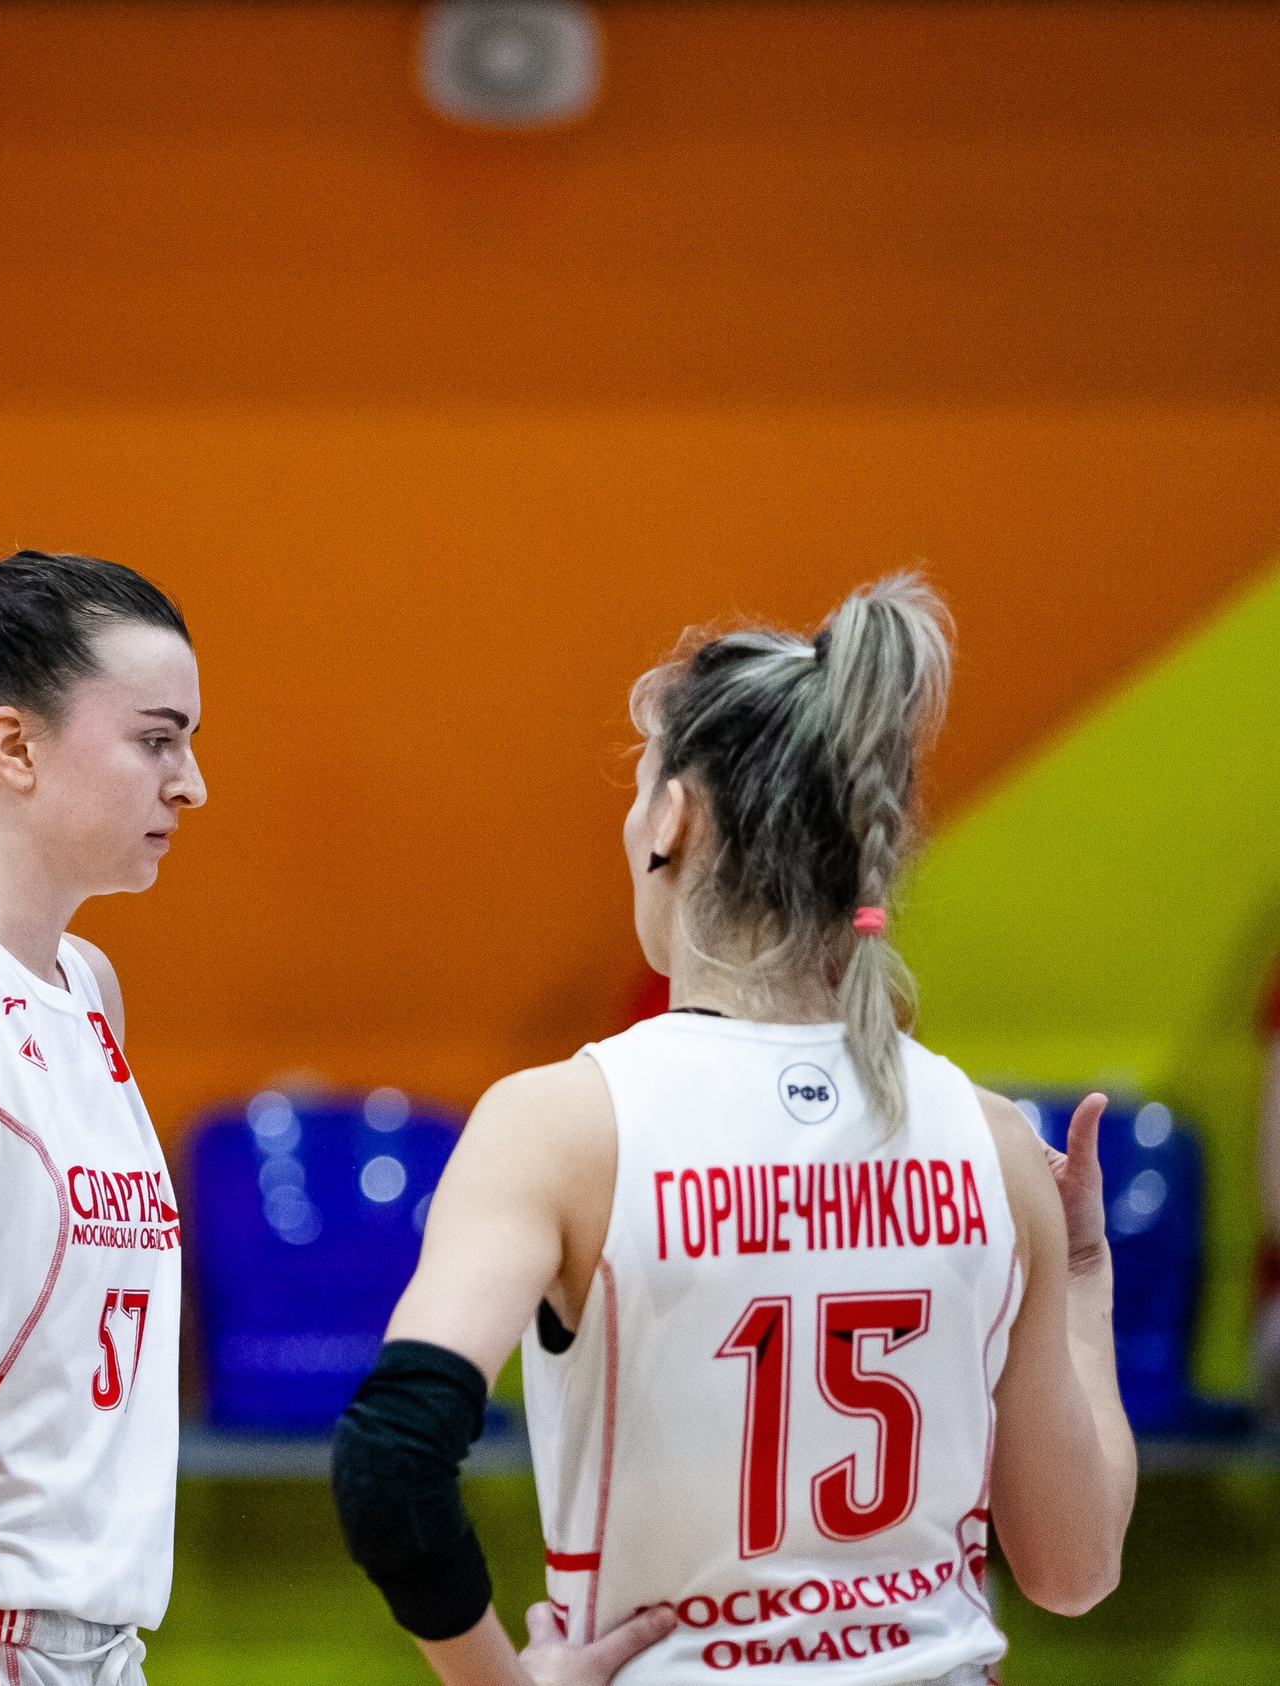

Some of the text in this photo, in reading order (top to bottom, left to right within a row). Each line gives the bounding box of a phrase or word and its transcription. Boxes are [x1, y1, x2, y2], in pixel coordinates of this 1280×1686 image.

[787, 1084, 829, 1101] РФБ
[654, 1158, 988, 1261] ГОРШЕЧНИКОВА
[91, 1288, 150, 1413] 57
[714, 1289, 931, 1560] 15
[640, 1561, 954, 1629] ОСКОВСКАЯ
[702, 1623, 910, 1670] ОБЛАСТЬ
